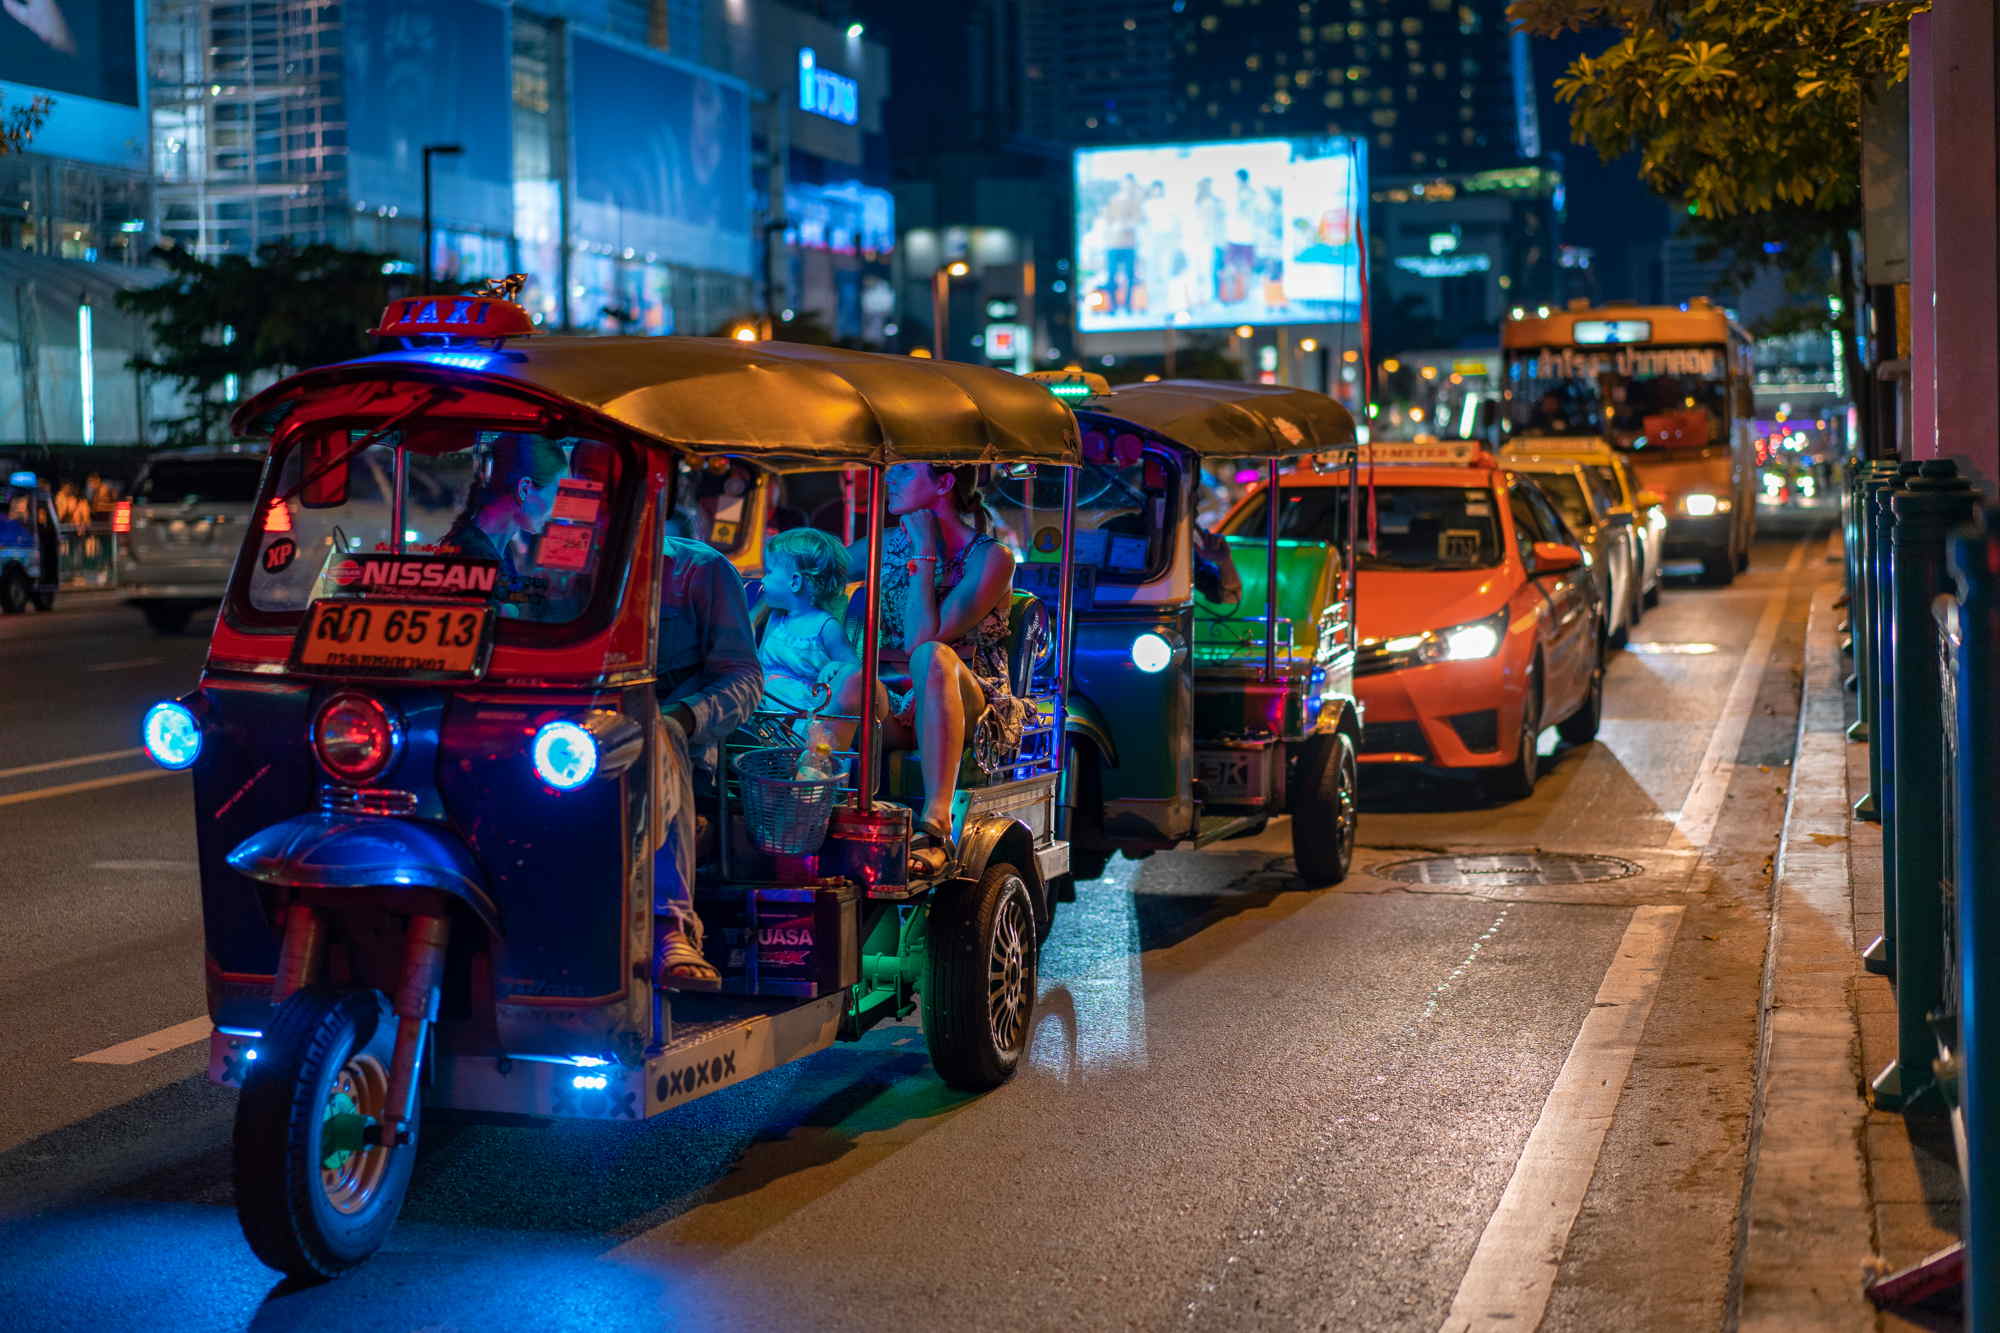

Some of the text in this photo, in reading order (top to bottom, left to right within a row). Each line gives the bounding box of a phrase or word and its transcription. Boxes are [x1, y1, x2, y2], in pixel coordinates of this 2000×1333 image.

[399, 300, 492, 325] TAXI
[362, 560, 497, 592] NISSAN
[384, 609, 477, 648] 6513
